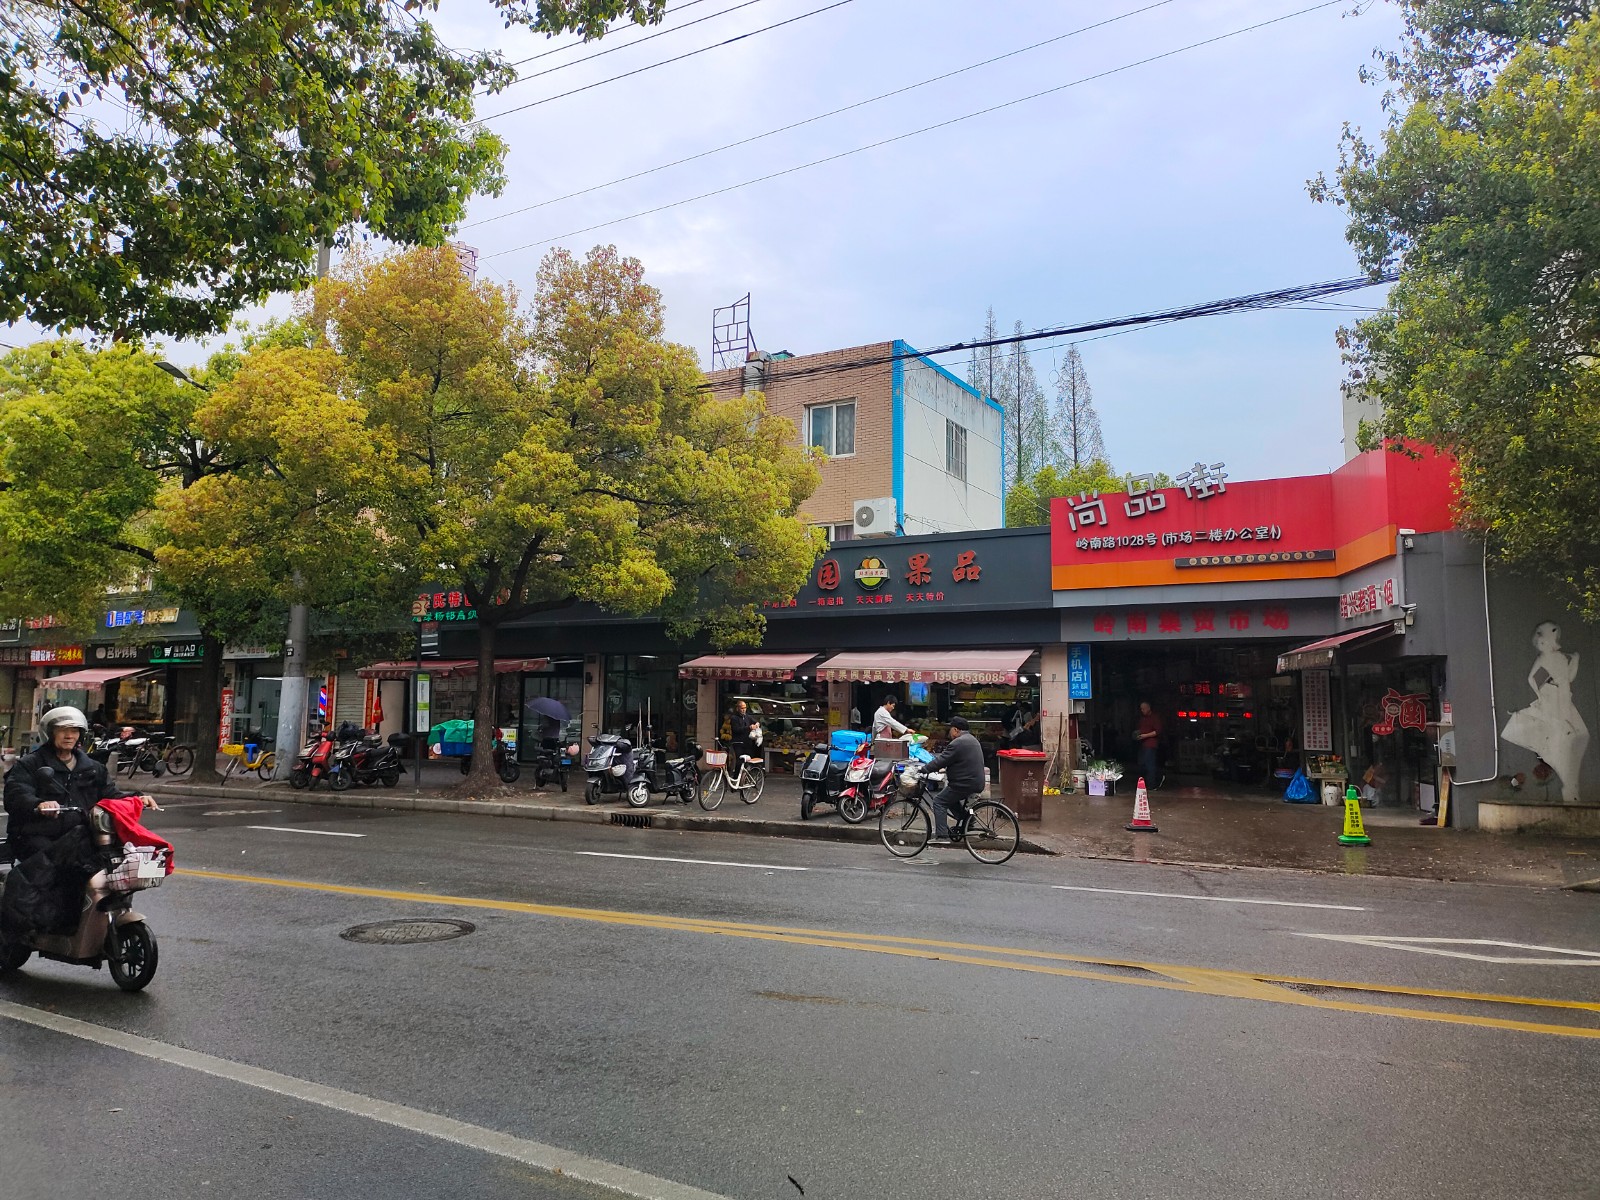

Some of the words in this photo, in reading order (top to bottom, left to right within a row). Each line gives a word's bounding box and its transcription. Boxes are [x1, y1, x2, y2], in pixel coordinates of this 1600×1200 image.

[1067, 462, 1228, 531] 尚品街
[1076, 534, 1157, 550] 岭南路1028号
[905, 550, 982, 586] 果品
[856, 594, 893, 604] 天天新鲜
[906, 592, 945, 602] 天天特价
[933, 671, 1005, 682] 13564536085
[1071, 647, 1082, 682] 手机店
